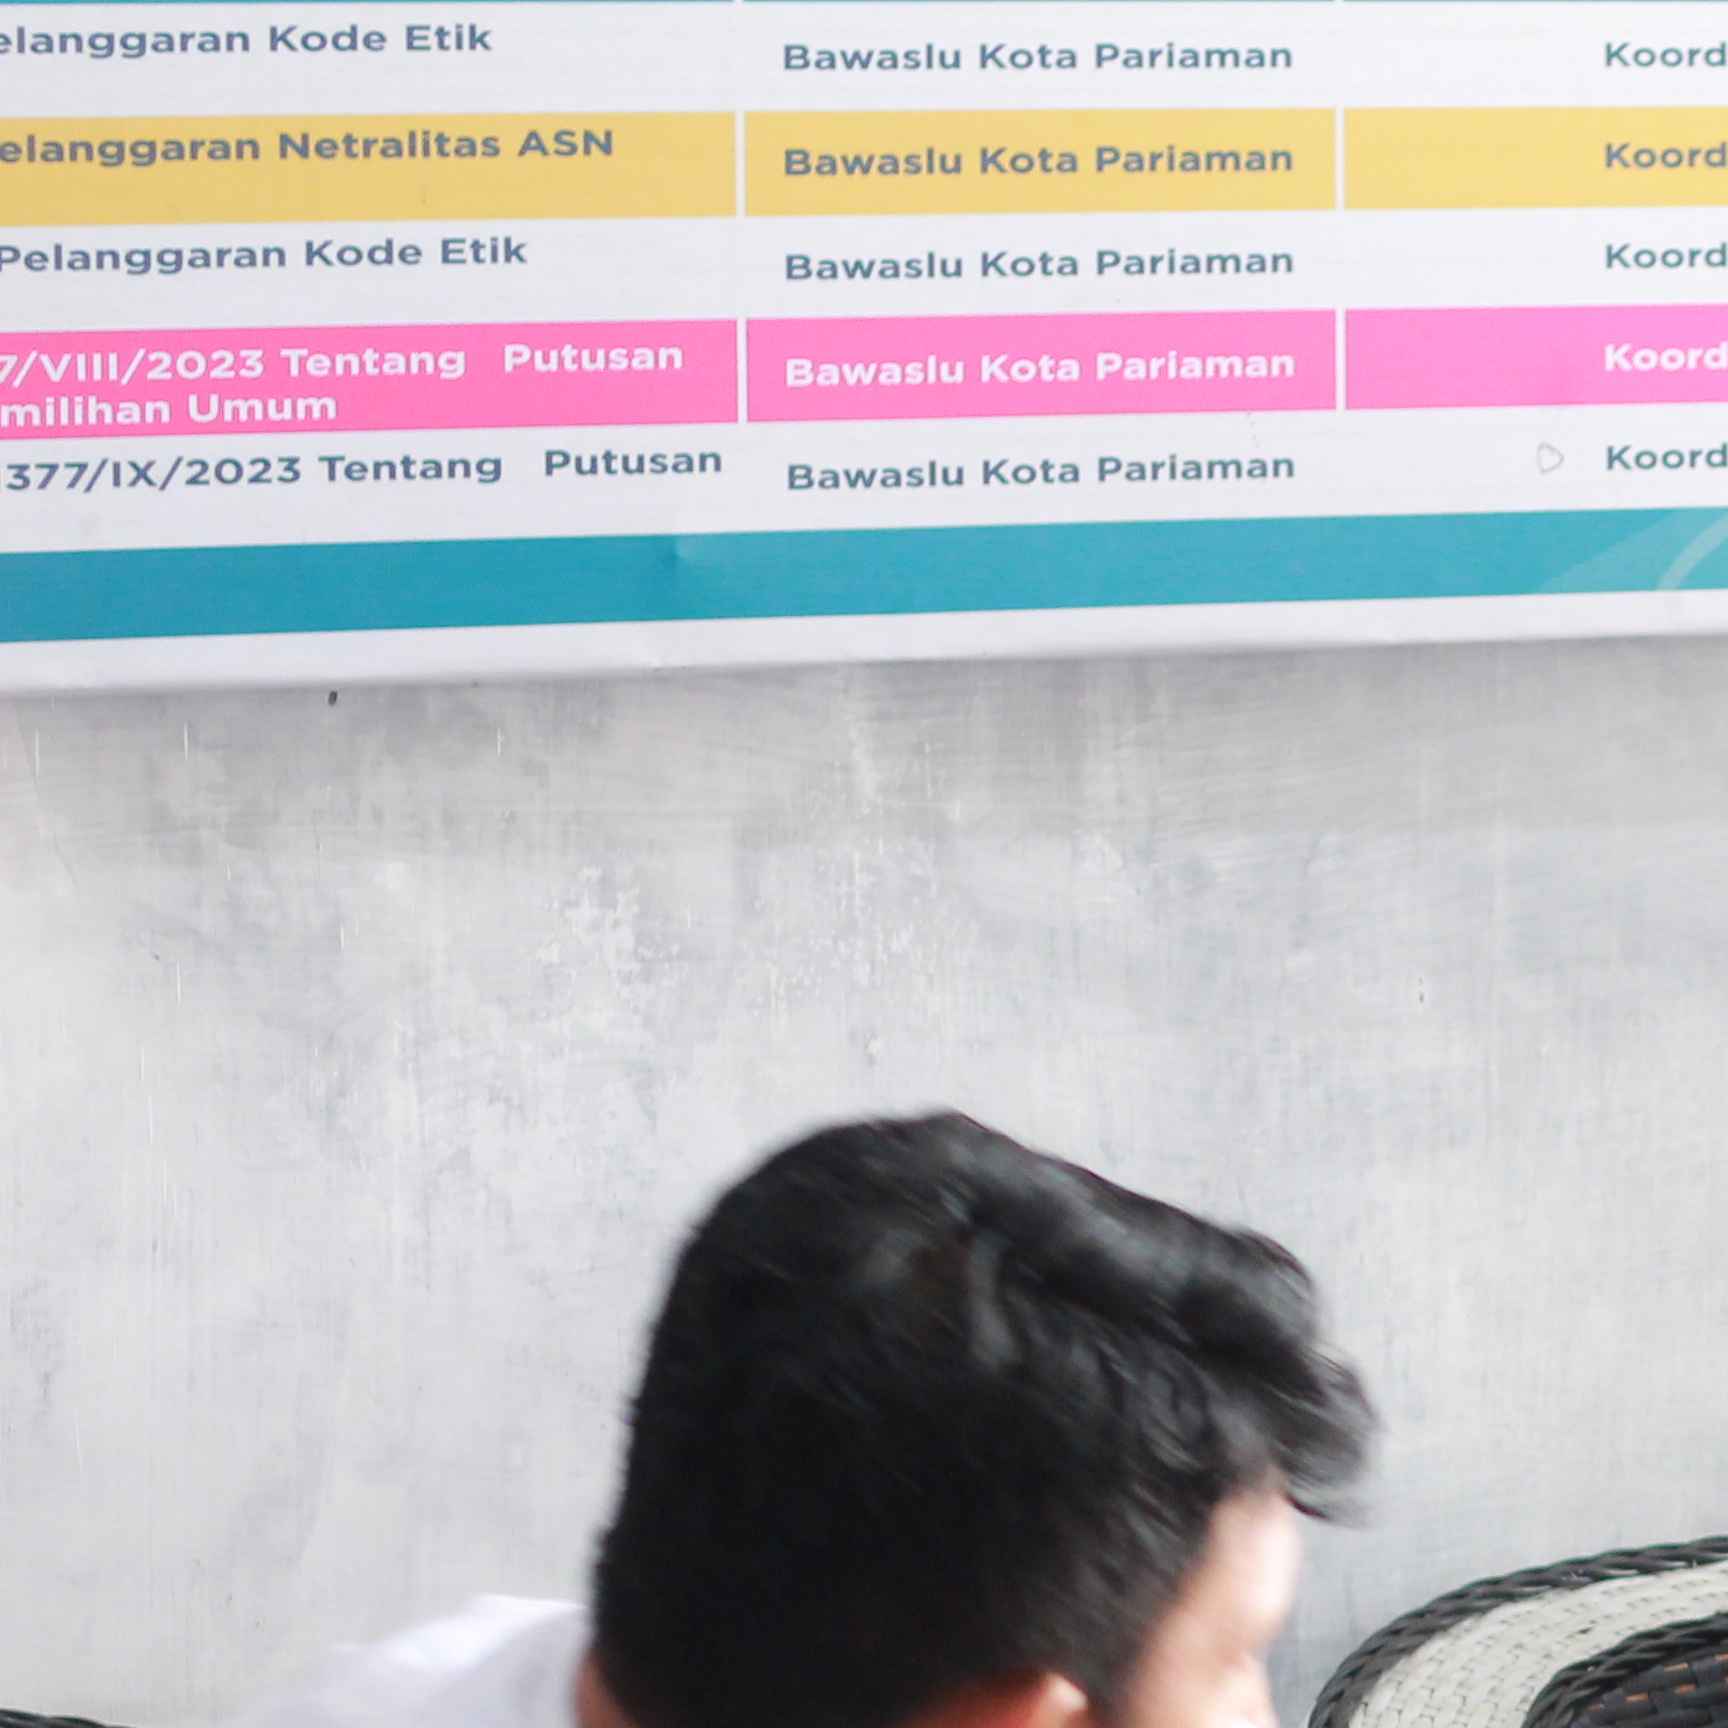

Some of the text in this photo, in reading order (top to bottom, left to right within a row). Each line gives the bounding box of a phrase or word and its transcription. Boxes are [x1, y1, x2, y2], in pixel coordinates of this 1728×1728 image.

[270, 24, 386, 52] Kode
[406, 24, 491, 51] Etik
[784, 43, 1291, 70] Bawaslu Kota Pariaman
[279, 130, 500, 160] Netralitas
[518, 130, 612, 156] ASN
[785, 145, 1292, 176] Bawaslu Kota Pariaman
[0, 237, 526, 275] Pelanggaran Kode Etik
[786, 249, 1292, 280] Bawaslu Kota Pariaman
[280, 349, 465, 379] Tentang
[505, 344, 682, 372] Putusan
[787, 351, 1296, 386] Bawaslu Kota Pariaman
[0, 394, 337, 427] milihan Umum
[7, 450, 721, 493] 377/IX/2023 Tentang Putusan
[788, 455, 1294, 490] Bawaslu Kota Pariaman
